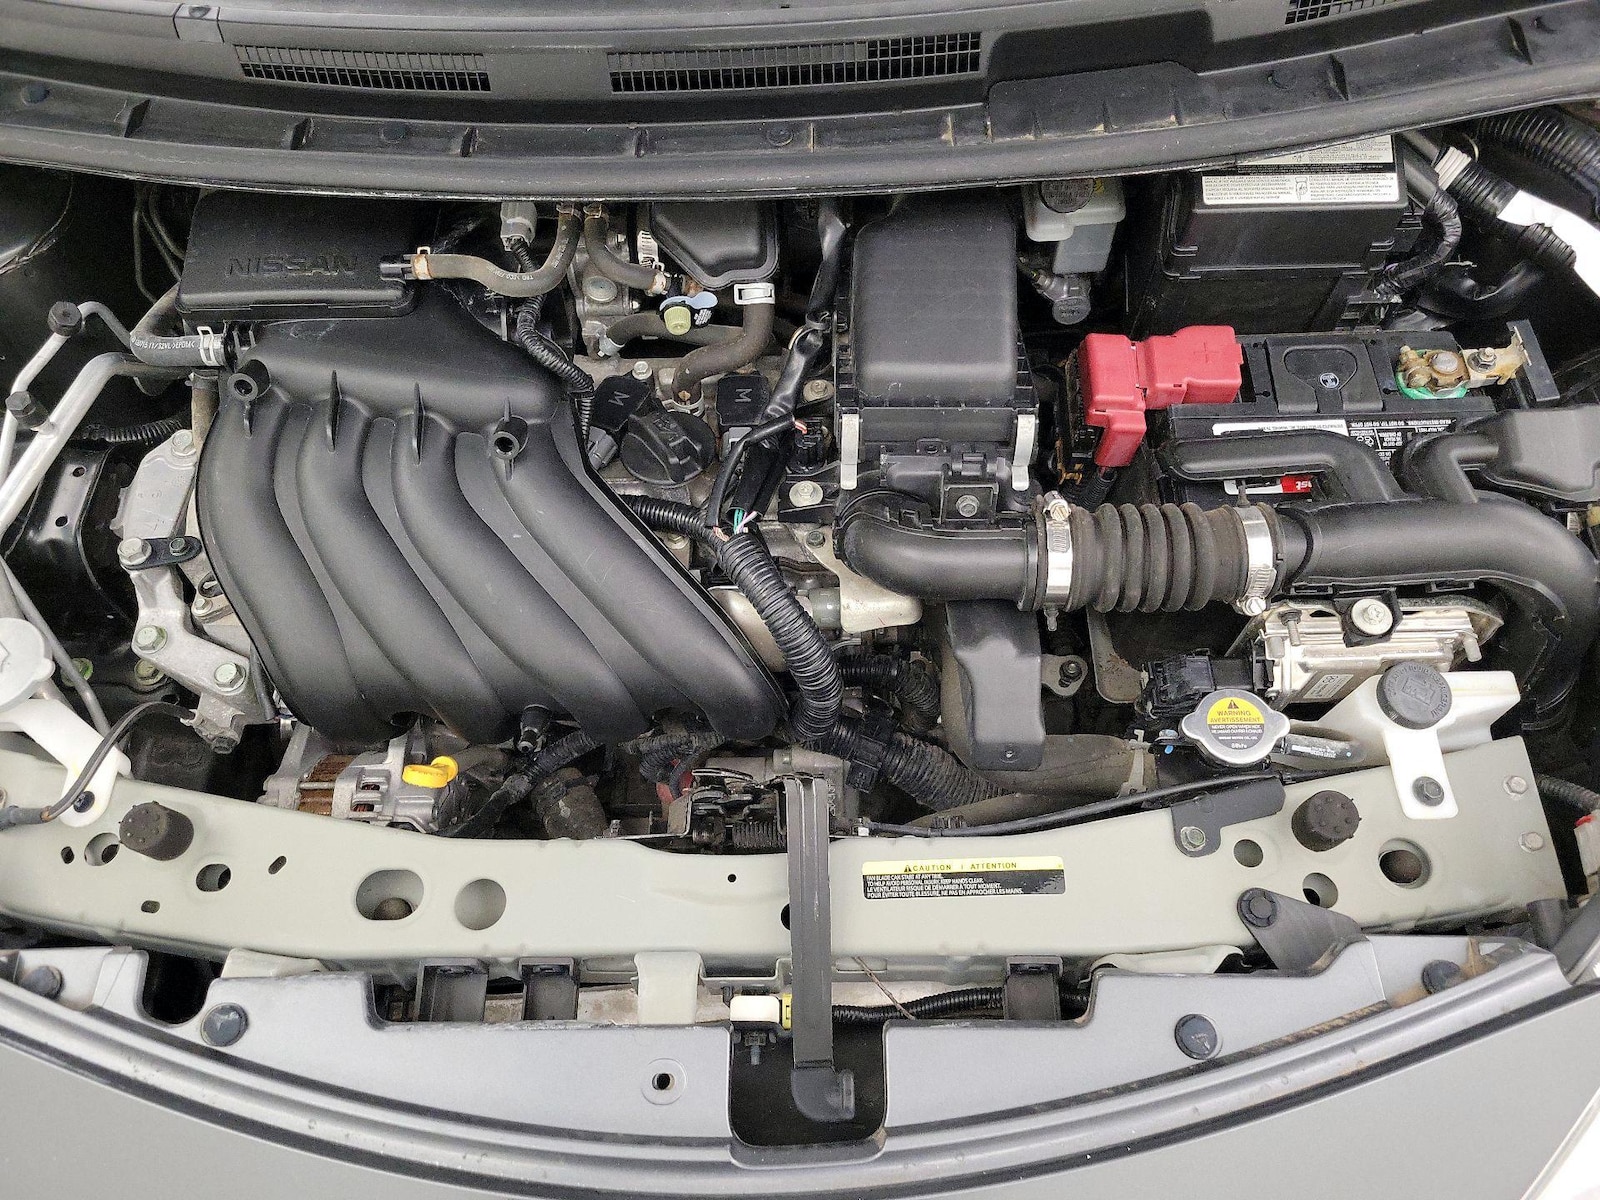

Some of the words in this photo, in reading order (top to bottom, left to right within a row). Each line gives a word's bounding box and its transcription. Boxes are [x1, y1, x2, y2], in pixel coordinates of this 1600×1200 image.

[225, 255, 358, 277] NISSAN
[608, 391, 630, 406] M
[735, 388, 753, 403] M
